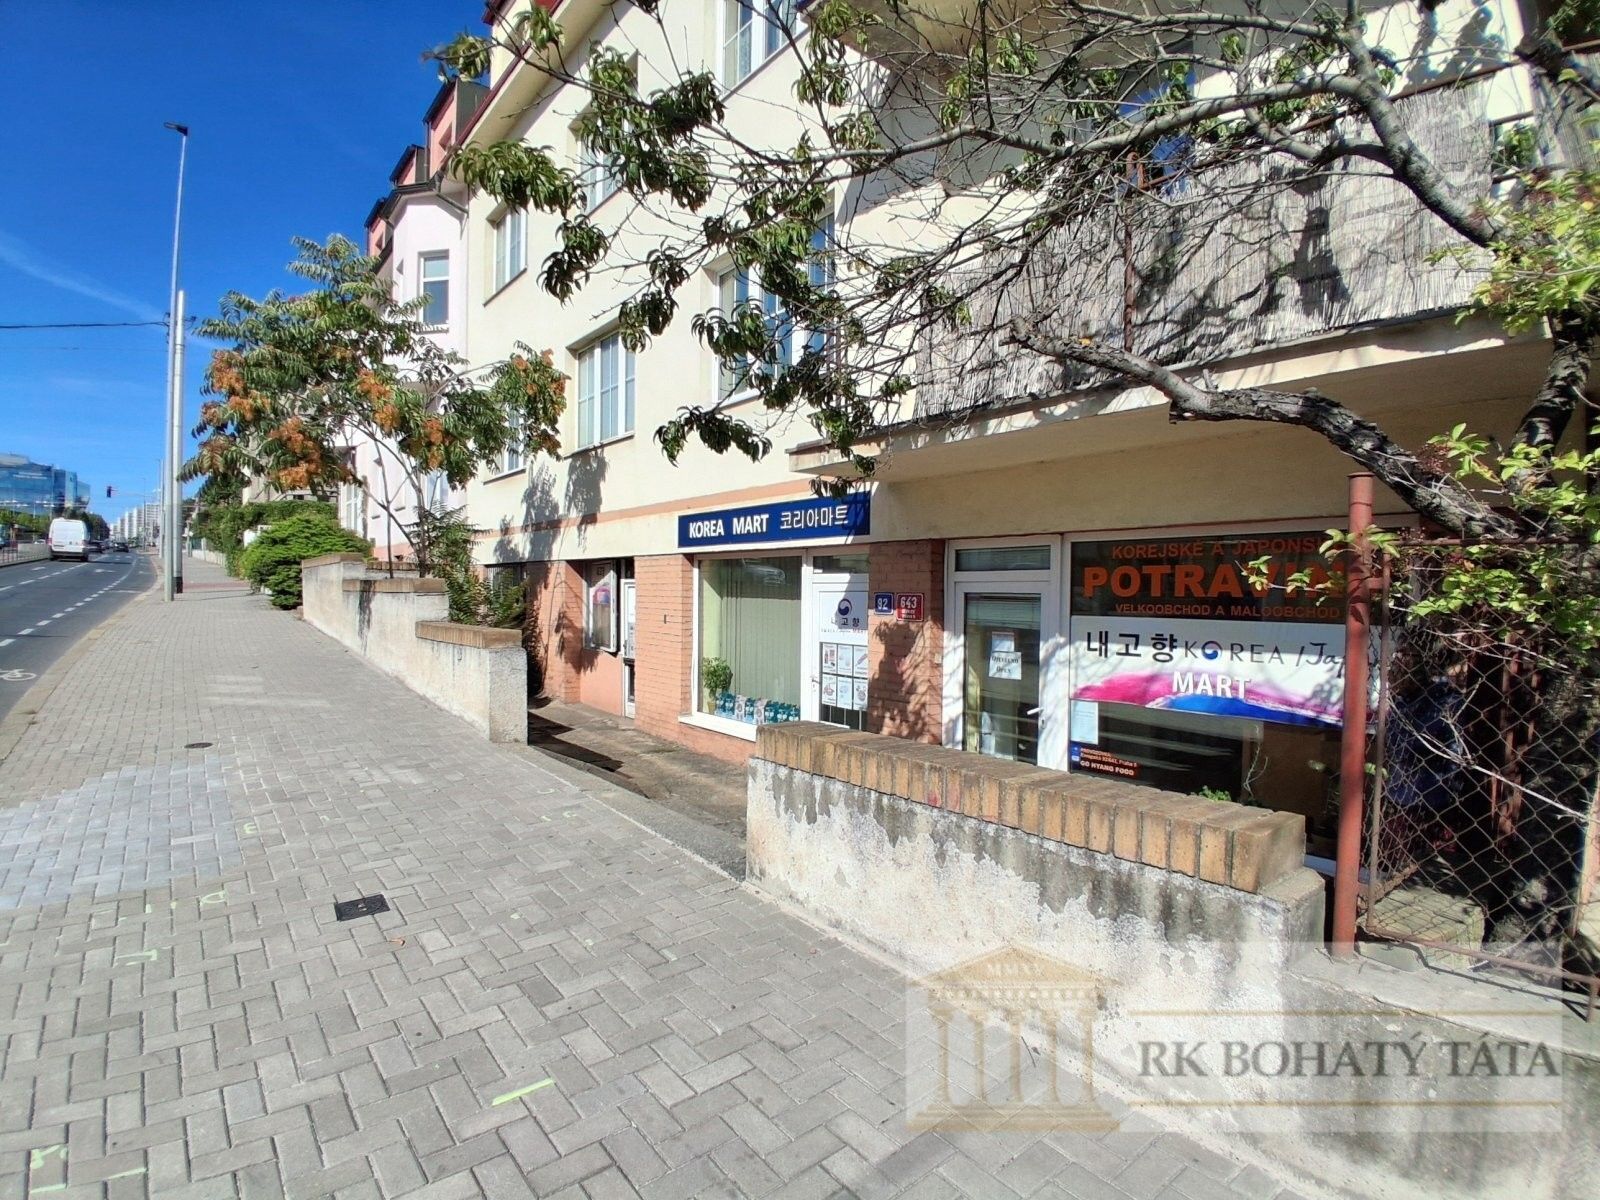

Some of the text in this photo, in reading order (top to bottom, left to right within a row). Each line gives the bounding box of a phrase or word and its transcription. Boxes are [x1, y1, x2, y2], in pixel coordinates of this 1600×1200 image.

[688, 505, 849, 539] KOREA MART 코리아마트
[1112, 537, 1344, 559] KOREJSKÉ A JAPONS
[1083, 561, 1346, 599] POTRAVIN
[877, 598, 889, 610] 92
[900, 596, 917, 609] 643
[1115, 603, 1340, 619] VELKOOBCHOD A MALOOBCHOD
[1086, 630, 1178, 663] 내고향
[1172, 671, 1251, 699] MART
